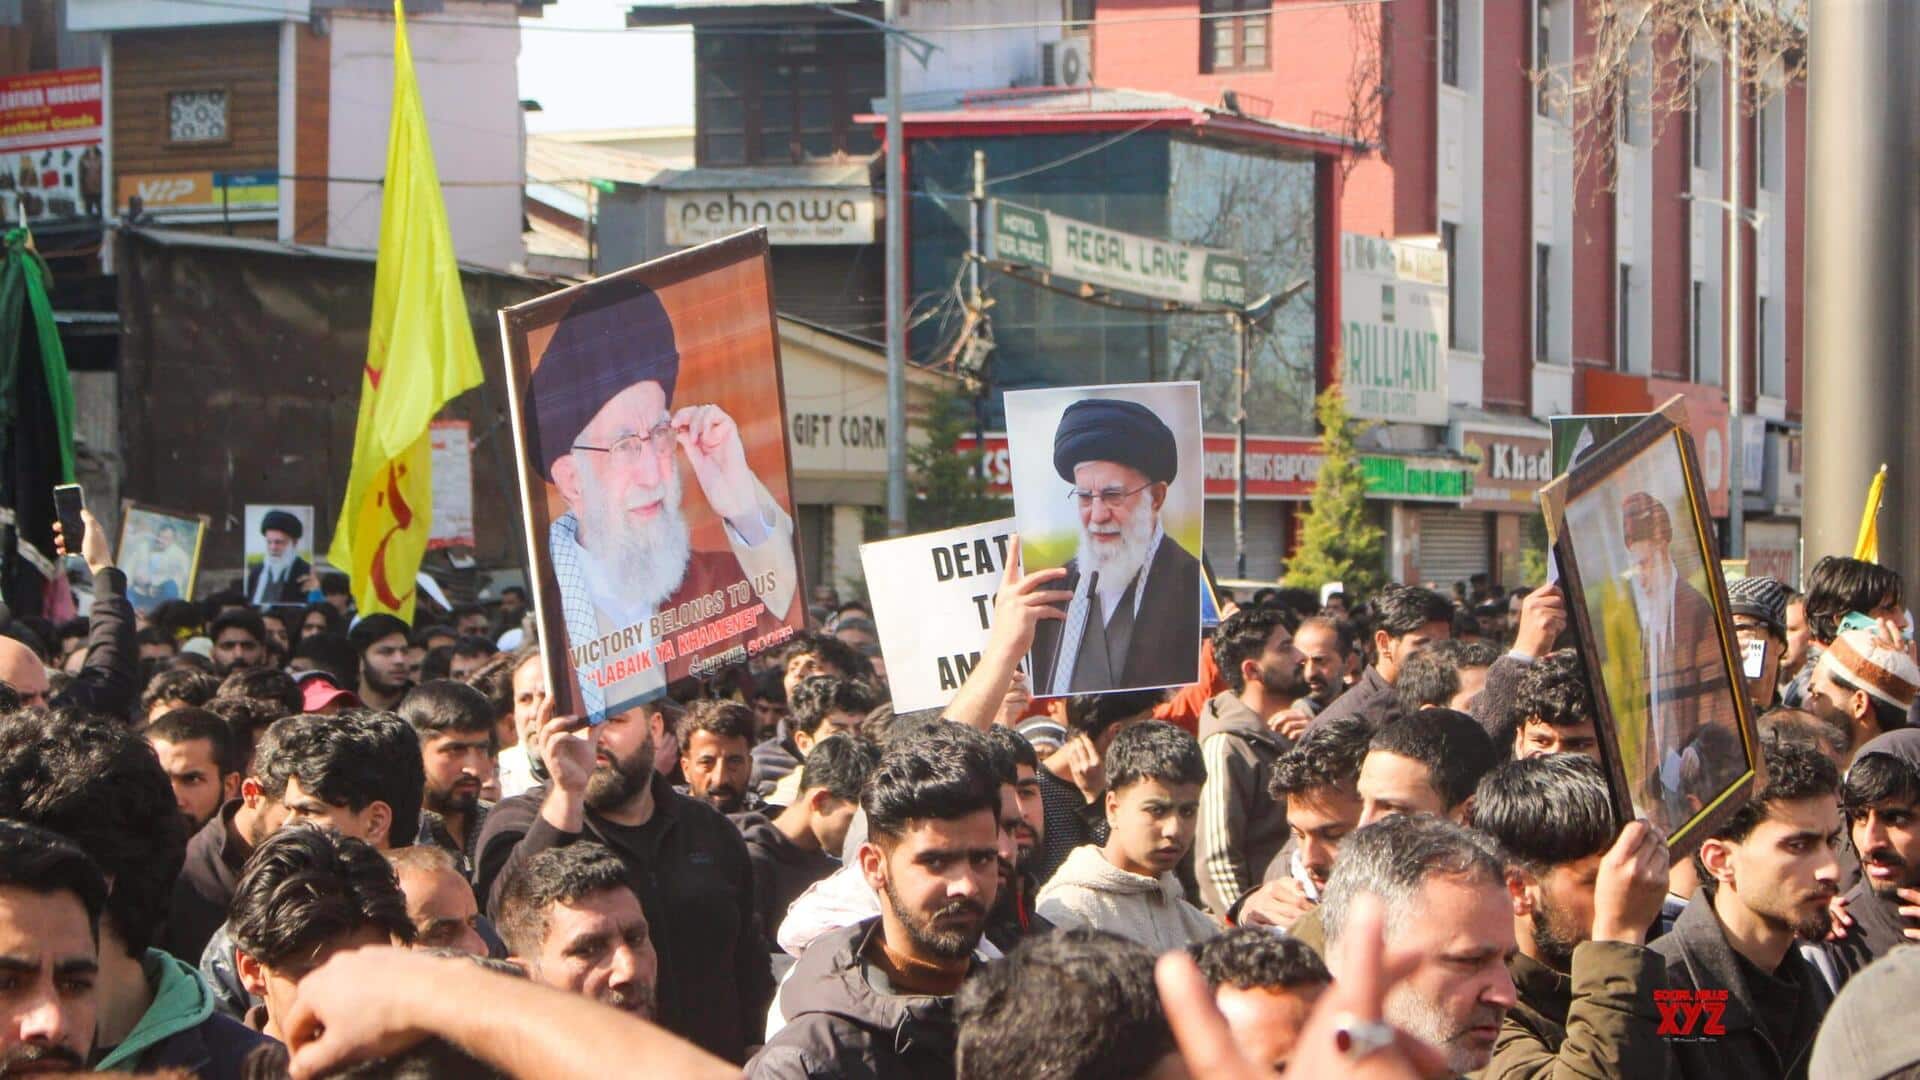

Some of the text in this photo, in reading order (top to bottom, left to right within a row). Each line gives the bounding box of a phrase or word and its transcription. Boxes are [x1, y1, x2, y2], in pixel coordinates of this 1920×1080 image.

[681, 191, 857, 230] pehnawa
[1066, 224, 1132, 272] REGAL
[1138, 244, 1189, 283] LANE
[793, 413, 832, 447] GIFT
[932, 533, 1013, 583] DEAT
[569, 622, 644, 669] VICTORY
[649, 590, 726, 638] BELONGS
[727, 579, 752, 609] TO
[754, 570, 777, 597] US
[972, 592, 998, 631] T
[655, 639, 677, 665] YA
